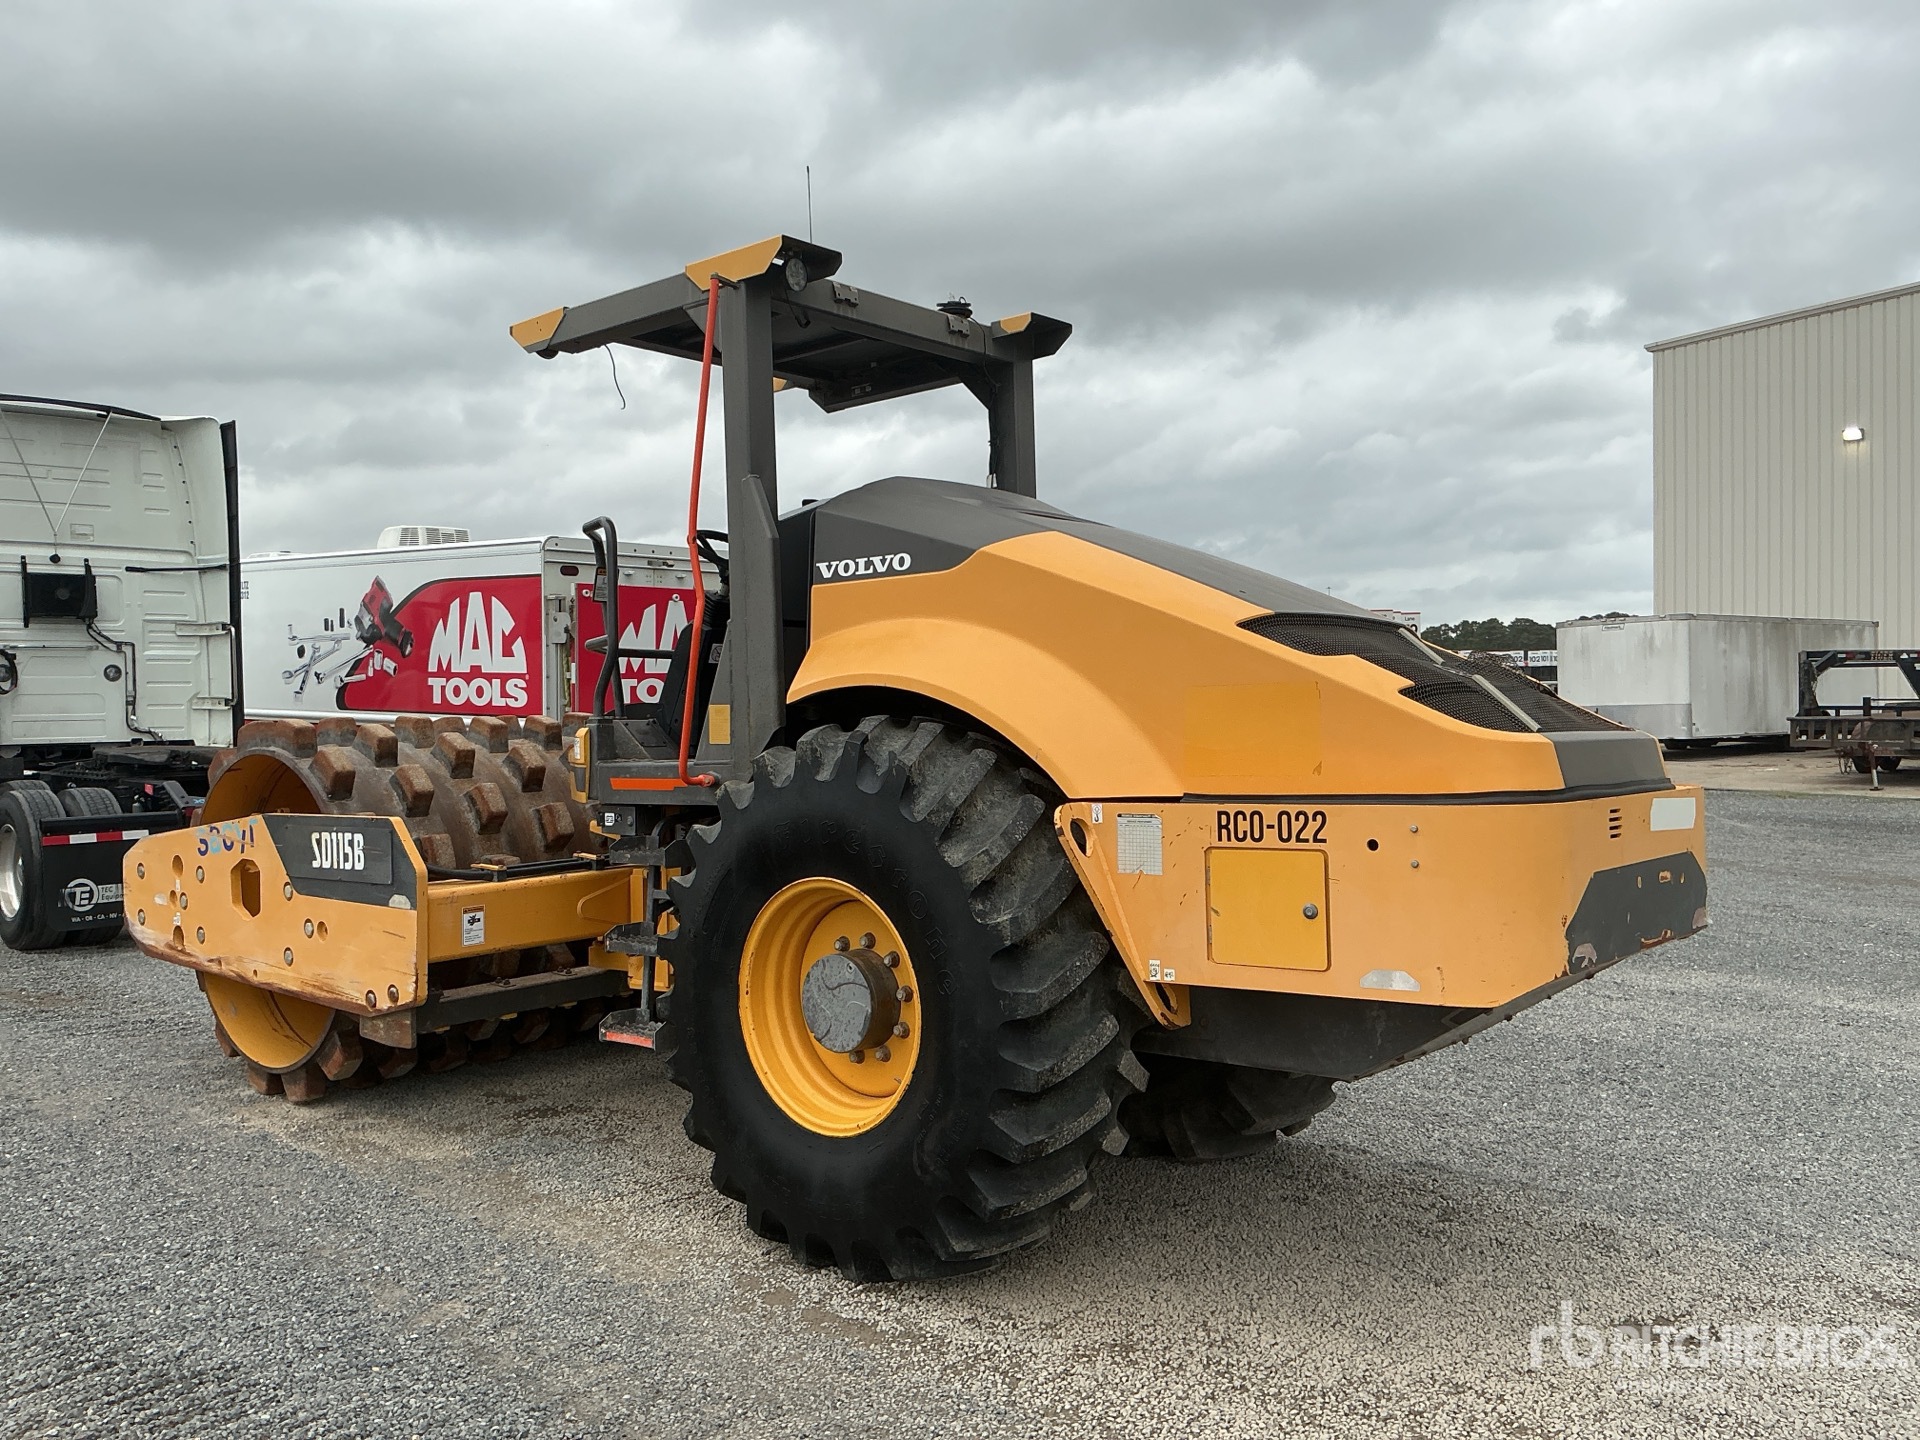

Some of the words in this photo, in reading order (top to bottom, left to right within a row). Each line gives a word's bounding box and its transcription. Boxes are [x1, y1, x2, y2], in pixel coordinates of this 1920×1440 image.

[816, 552, 912, 579] VOLVO
[427, 591, 529, 674] MAC
[618, 600, 691, 674] MA
[427, 677, 529, 708] TOOLS
[311, 831, 365, 871] SD115B
